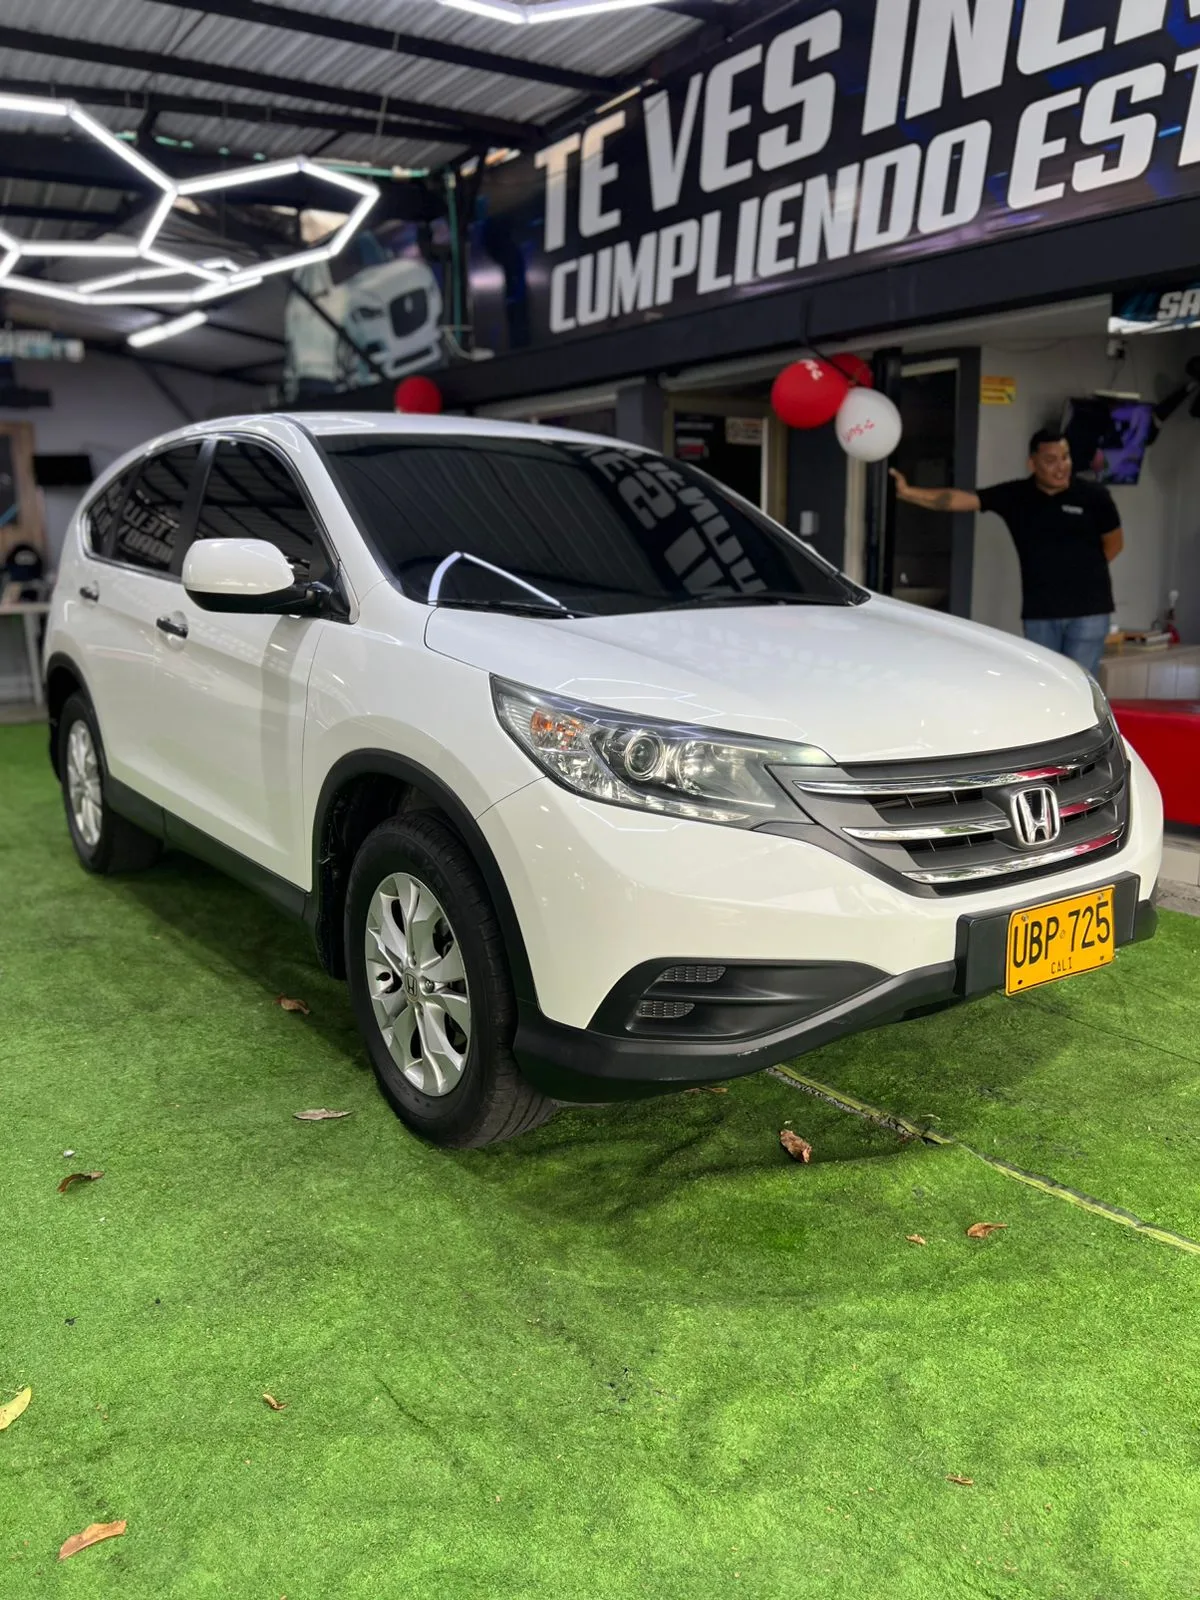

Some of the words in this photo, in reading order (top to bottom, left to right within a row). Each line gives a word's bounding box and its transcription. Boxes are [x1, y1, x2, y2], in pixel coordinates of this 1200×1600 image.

[534, 111, 626, 252] TE
[643, 8, 843, 212] VES
[549, 119, 992, 333] CUMPLIENDO
[1013, 916, 1060, 968] UBP
[1068, 901, 1110, 952] 725
[1050, 957, 1073, 974] CALI
